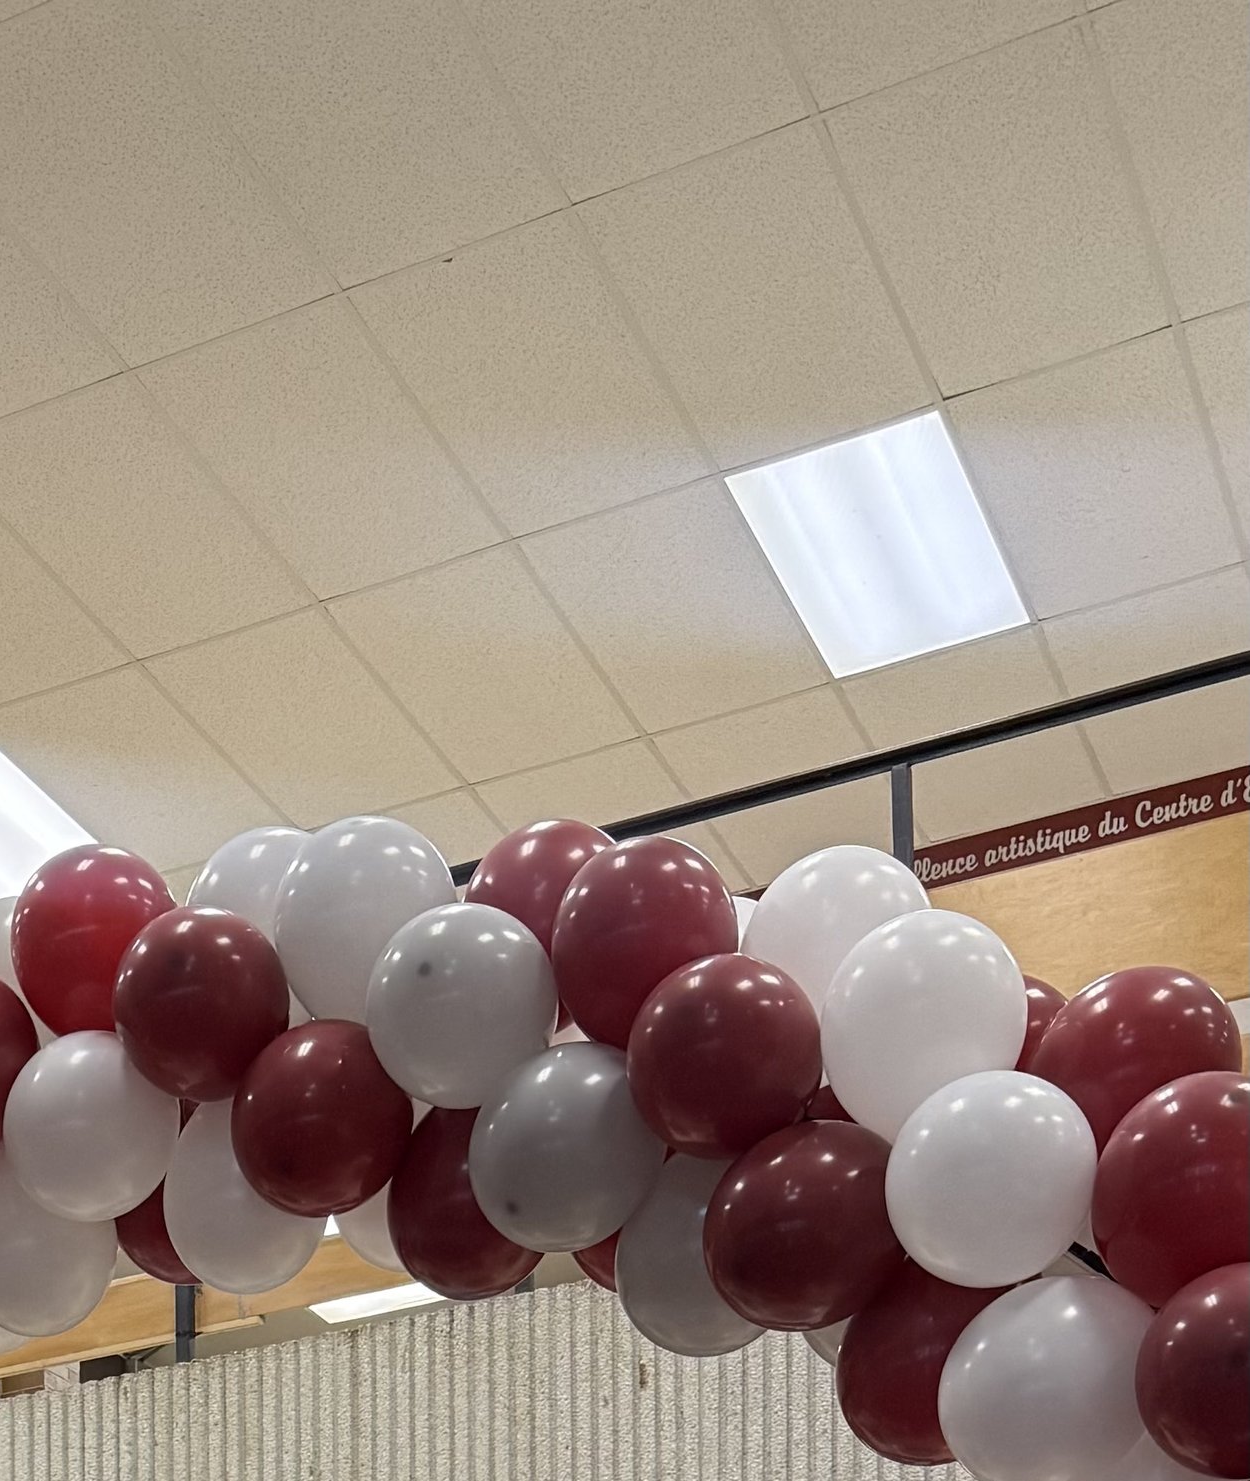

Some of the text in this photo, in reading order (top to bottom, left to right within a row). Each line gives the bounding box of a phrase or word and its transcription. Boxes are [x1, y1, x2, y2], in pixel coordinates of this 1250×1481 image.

[985, 824, 1091, 868] artistique
[1098, 812, 1128, 838] du
[1135, 790, 1214, 828] Centre
